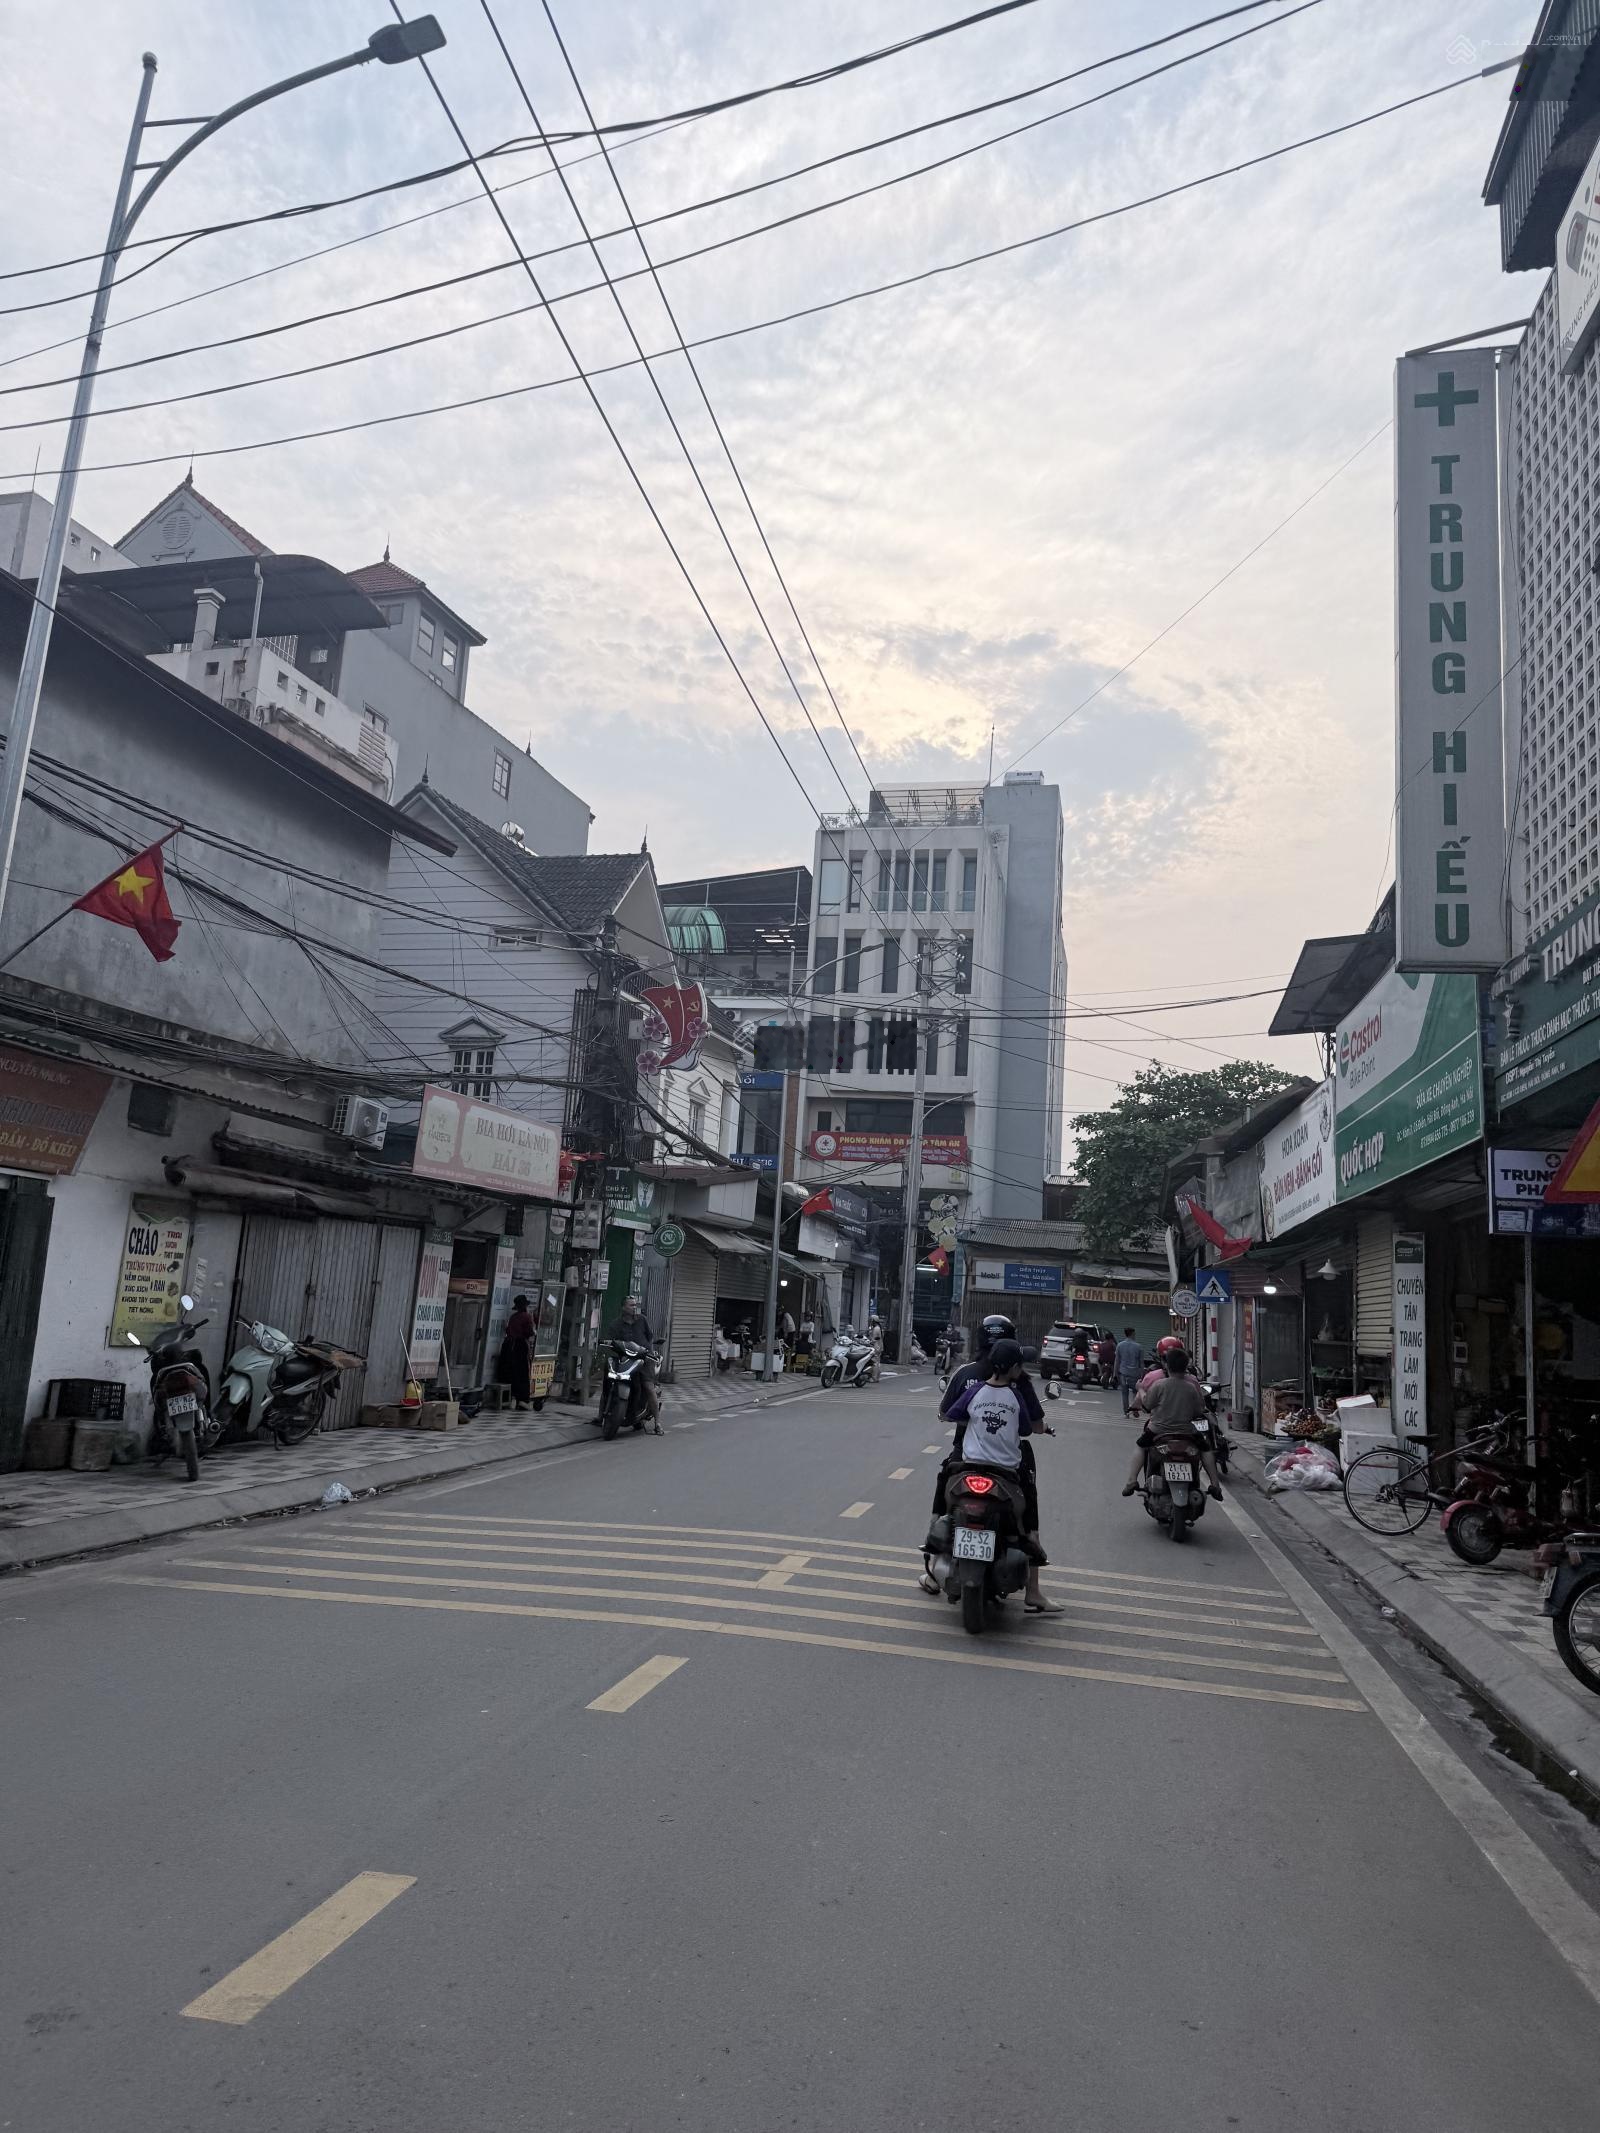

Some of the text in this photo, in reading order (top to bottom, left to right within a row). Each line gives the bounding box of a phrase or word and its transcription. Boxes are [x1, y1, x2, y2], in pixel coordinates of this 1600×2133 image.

[1429, 454, 1472, 947] TRUNG HIẾU
[1572, 993, 1591, 1022] THUỐC
[1350, 1005, 1383, 1062] Castrol
[1350, 1056, 1376, 1089] Bike Point
[1432, 1072, 1453, 1099] CHUYÊN
[1453, 1056, 1473, 1085] NGHIỆP
[475, 1117, 494, 1137] BIA
[496, 1120, 516, 1144] HƠI
[1281, 1135, 1293, 1159] HOA
[1340, 1130, 1385, 1187] QUỐC HỢP
[128, 1221, 159, 1256] CHÁO
[126, 1261, 146, 1272] TRỨNG
[981, 1272, 1000, 1280] Mobil
[1074, 1287, 1104, 1300] CƠM
[1396, 1276, 1424, 1295] CHUYÊN
[1399, 1330, 1423, 1349] TRANG
[1403, 1379, 1418, 1401] MỚI
[1404, 1406, 1418, 1428] CÁC
[957, 1543, 992, 1559] 165.30
